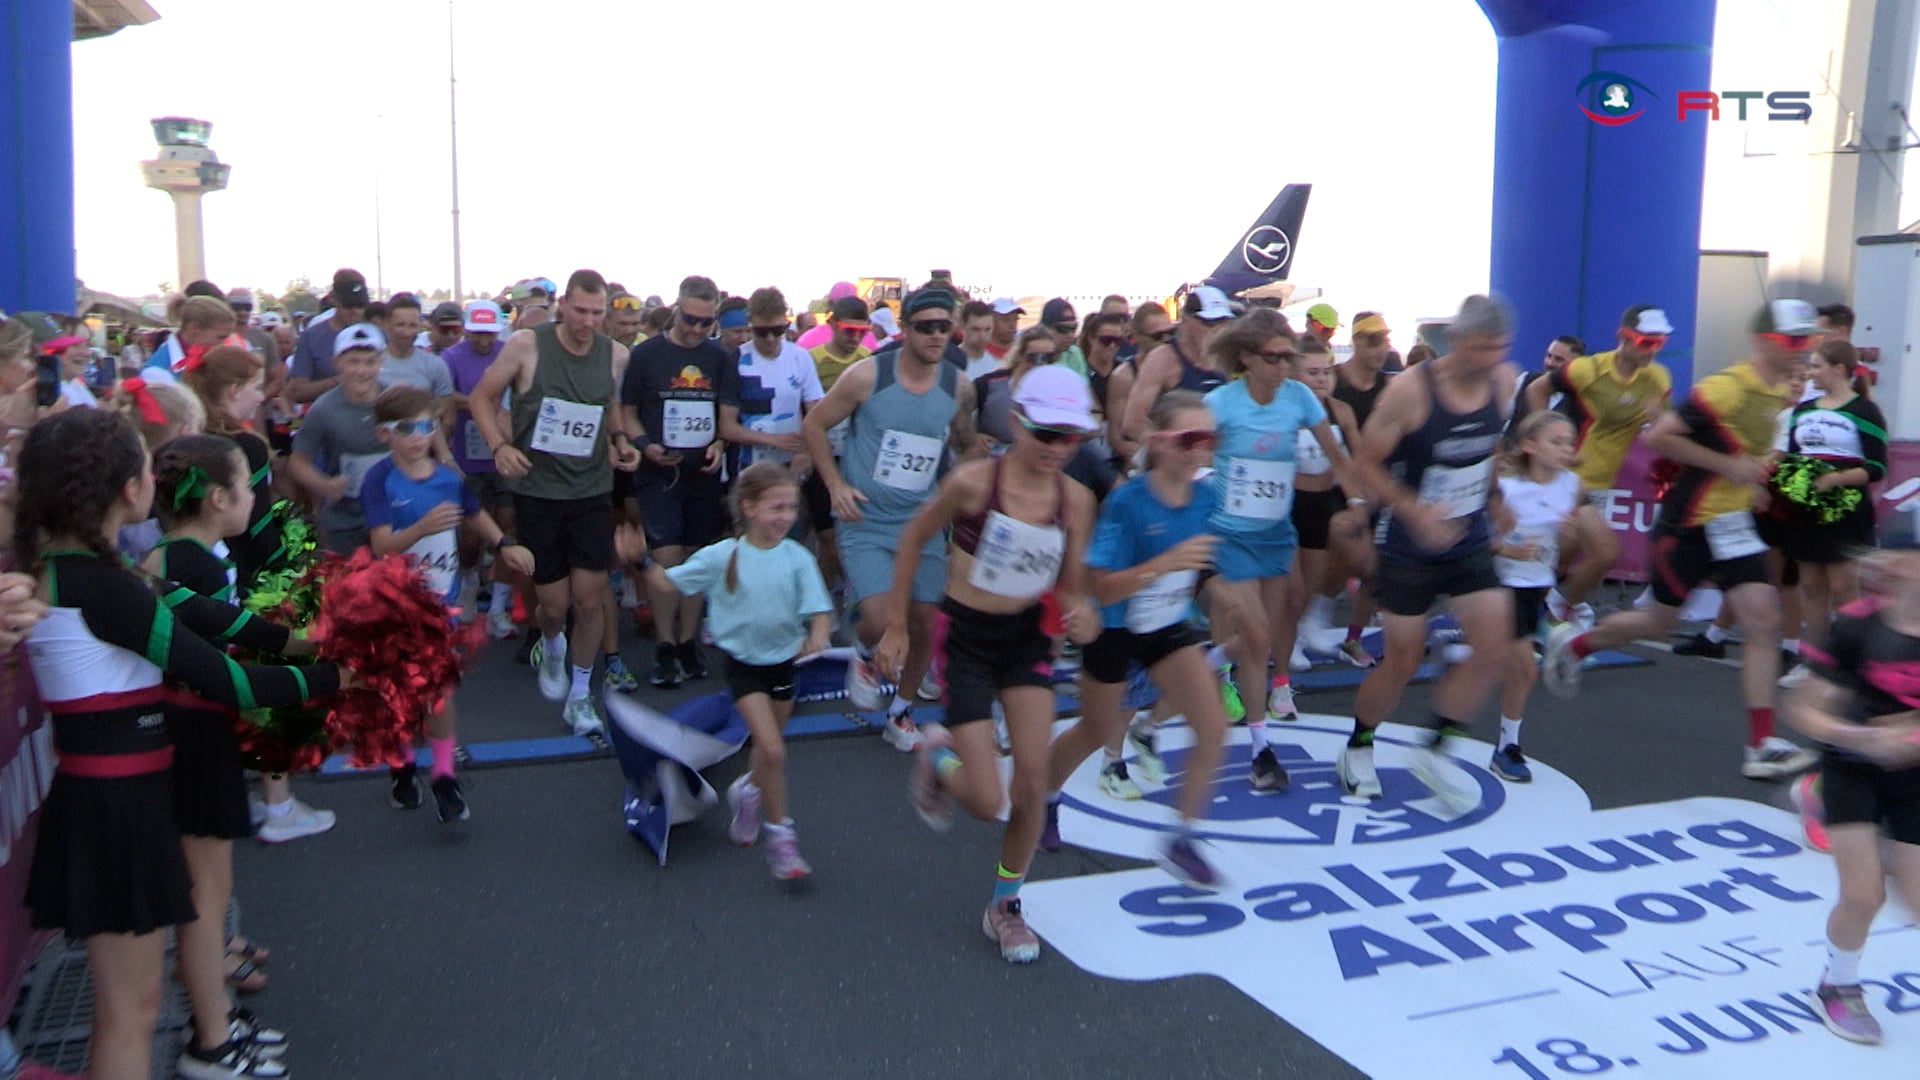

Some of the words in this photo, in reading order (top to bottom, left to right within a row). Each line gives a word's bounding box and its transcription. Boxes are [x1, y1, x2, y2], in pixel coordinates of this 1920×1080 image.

[562, 420, 595, 438] 162
[683, 417, 713, 432] 326
[901, 453, 936, 472] 327
[1252, 480, 1287, 499] 331
[1119, 819, 1805, 938] Salzburg
[1327, 867, 1824, 982] Airport
[1559, 935, 1782, 998] LAUF
[1492, 1038, 1641, 1080] 18.
[1655, 990, 1826, 1055] JUN
